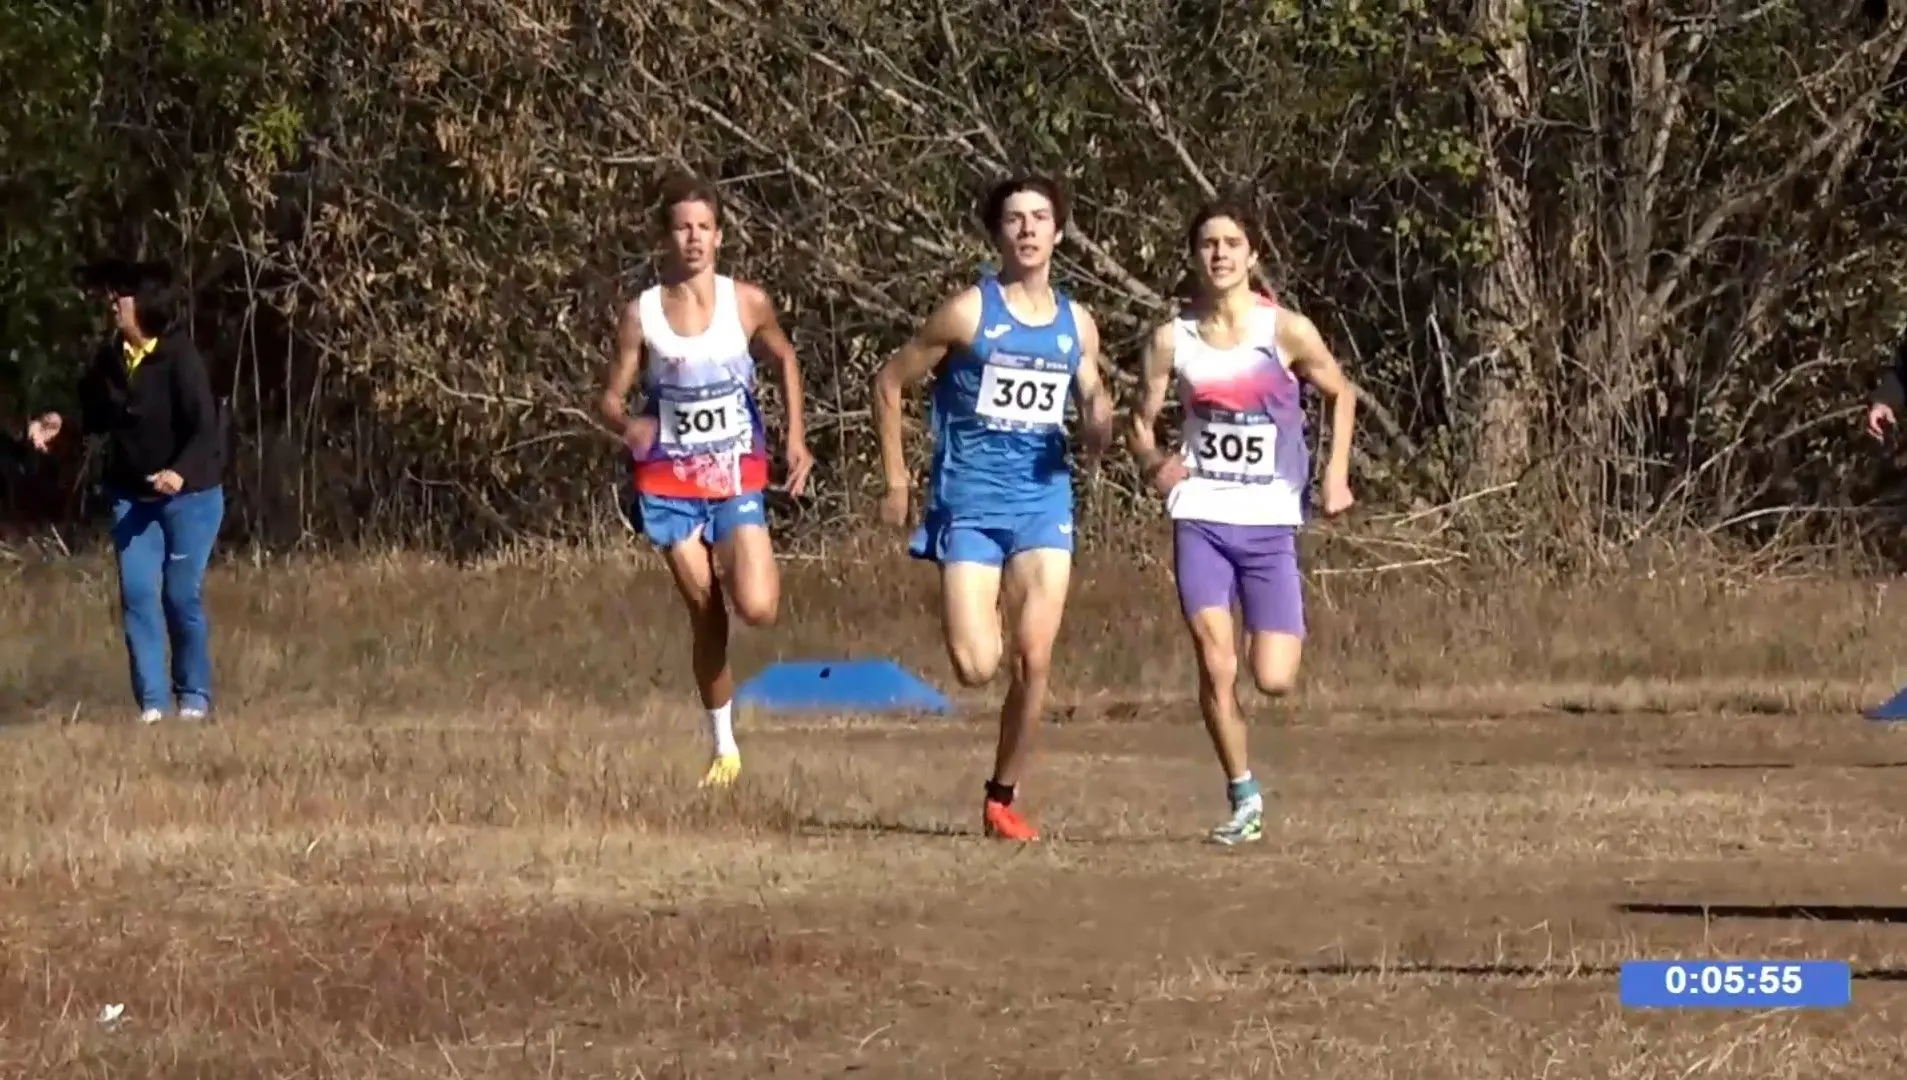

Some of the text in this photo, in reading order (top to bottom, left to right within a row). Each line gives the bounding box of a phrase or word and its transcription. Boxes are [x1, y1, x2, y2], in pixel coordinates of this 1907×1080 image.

[992, 377, 1058, 412] 303
[674, 405, 727, 436] 301
[1199, 430, 1265, 465] 305
